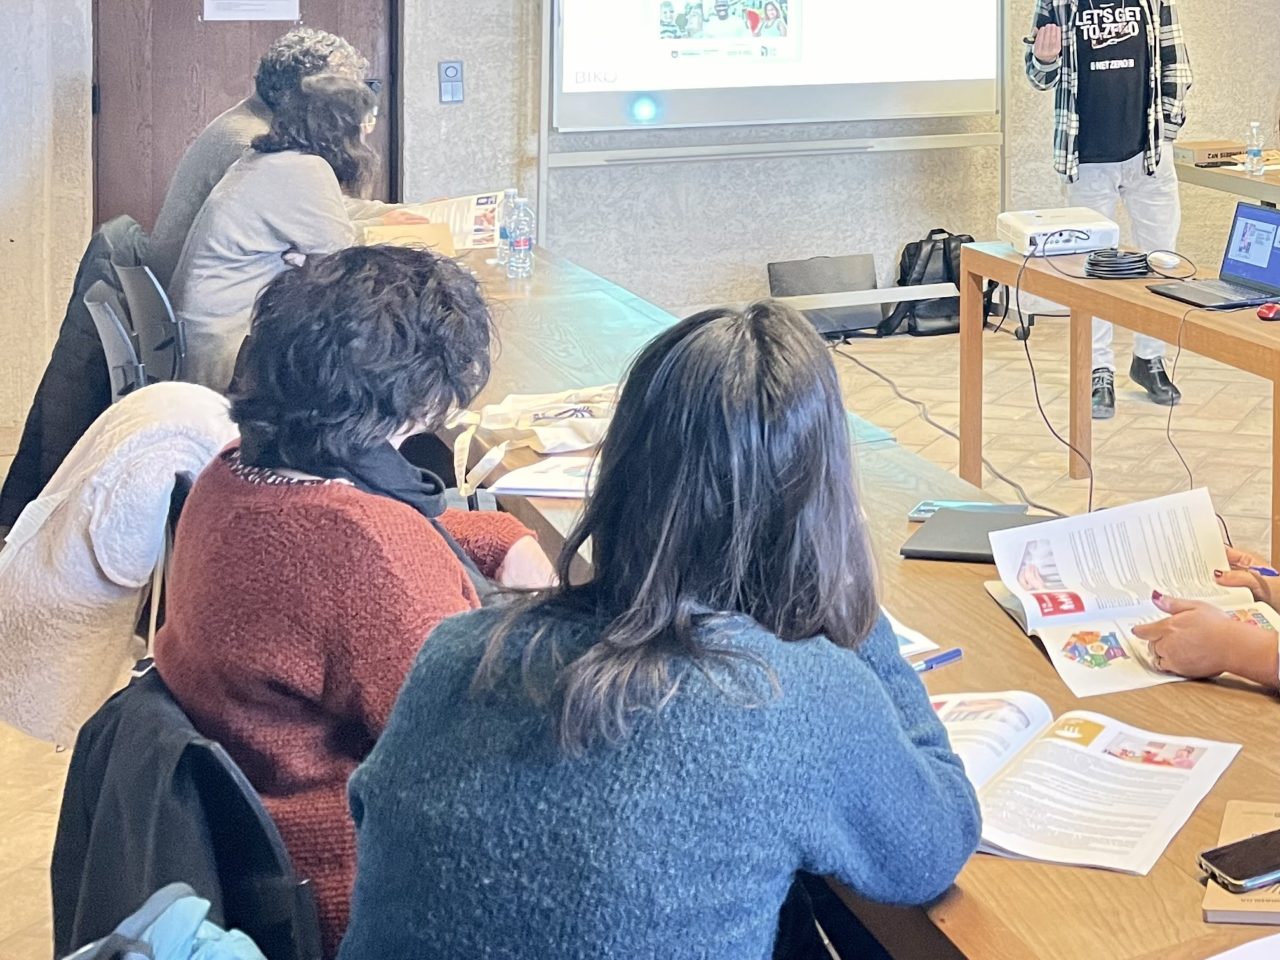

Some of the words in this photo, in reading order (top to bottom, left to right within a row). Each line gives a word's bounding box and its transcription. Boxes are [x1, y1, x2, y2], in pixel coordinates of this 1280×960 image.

[1075, 8, 1114, 26] LET'S
[1115, 7, 1141, 22] GET
[1080, 25, 1100, 40] TO
